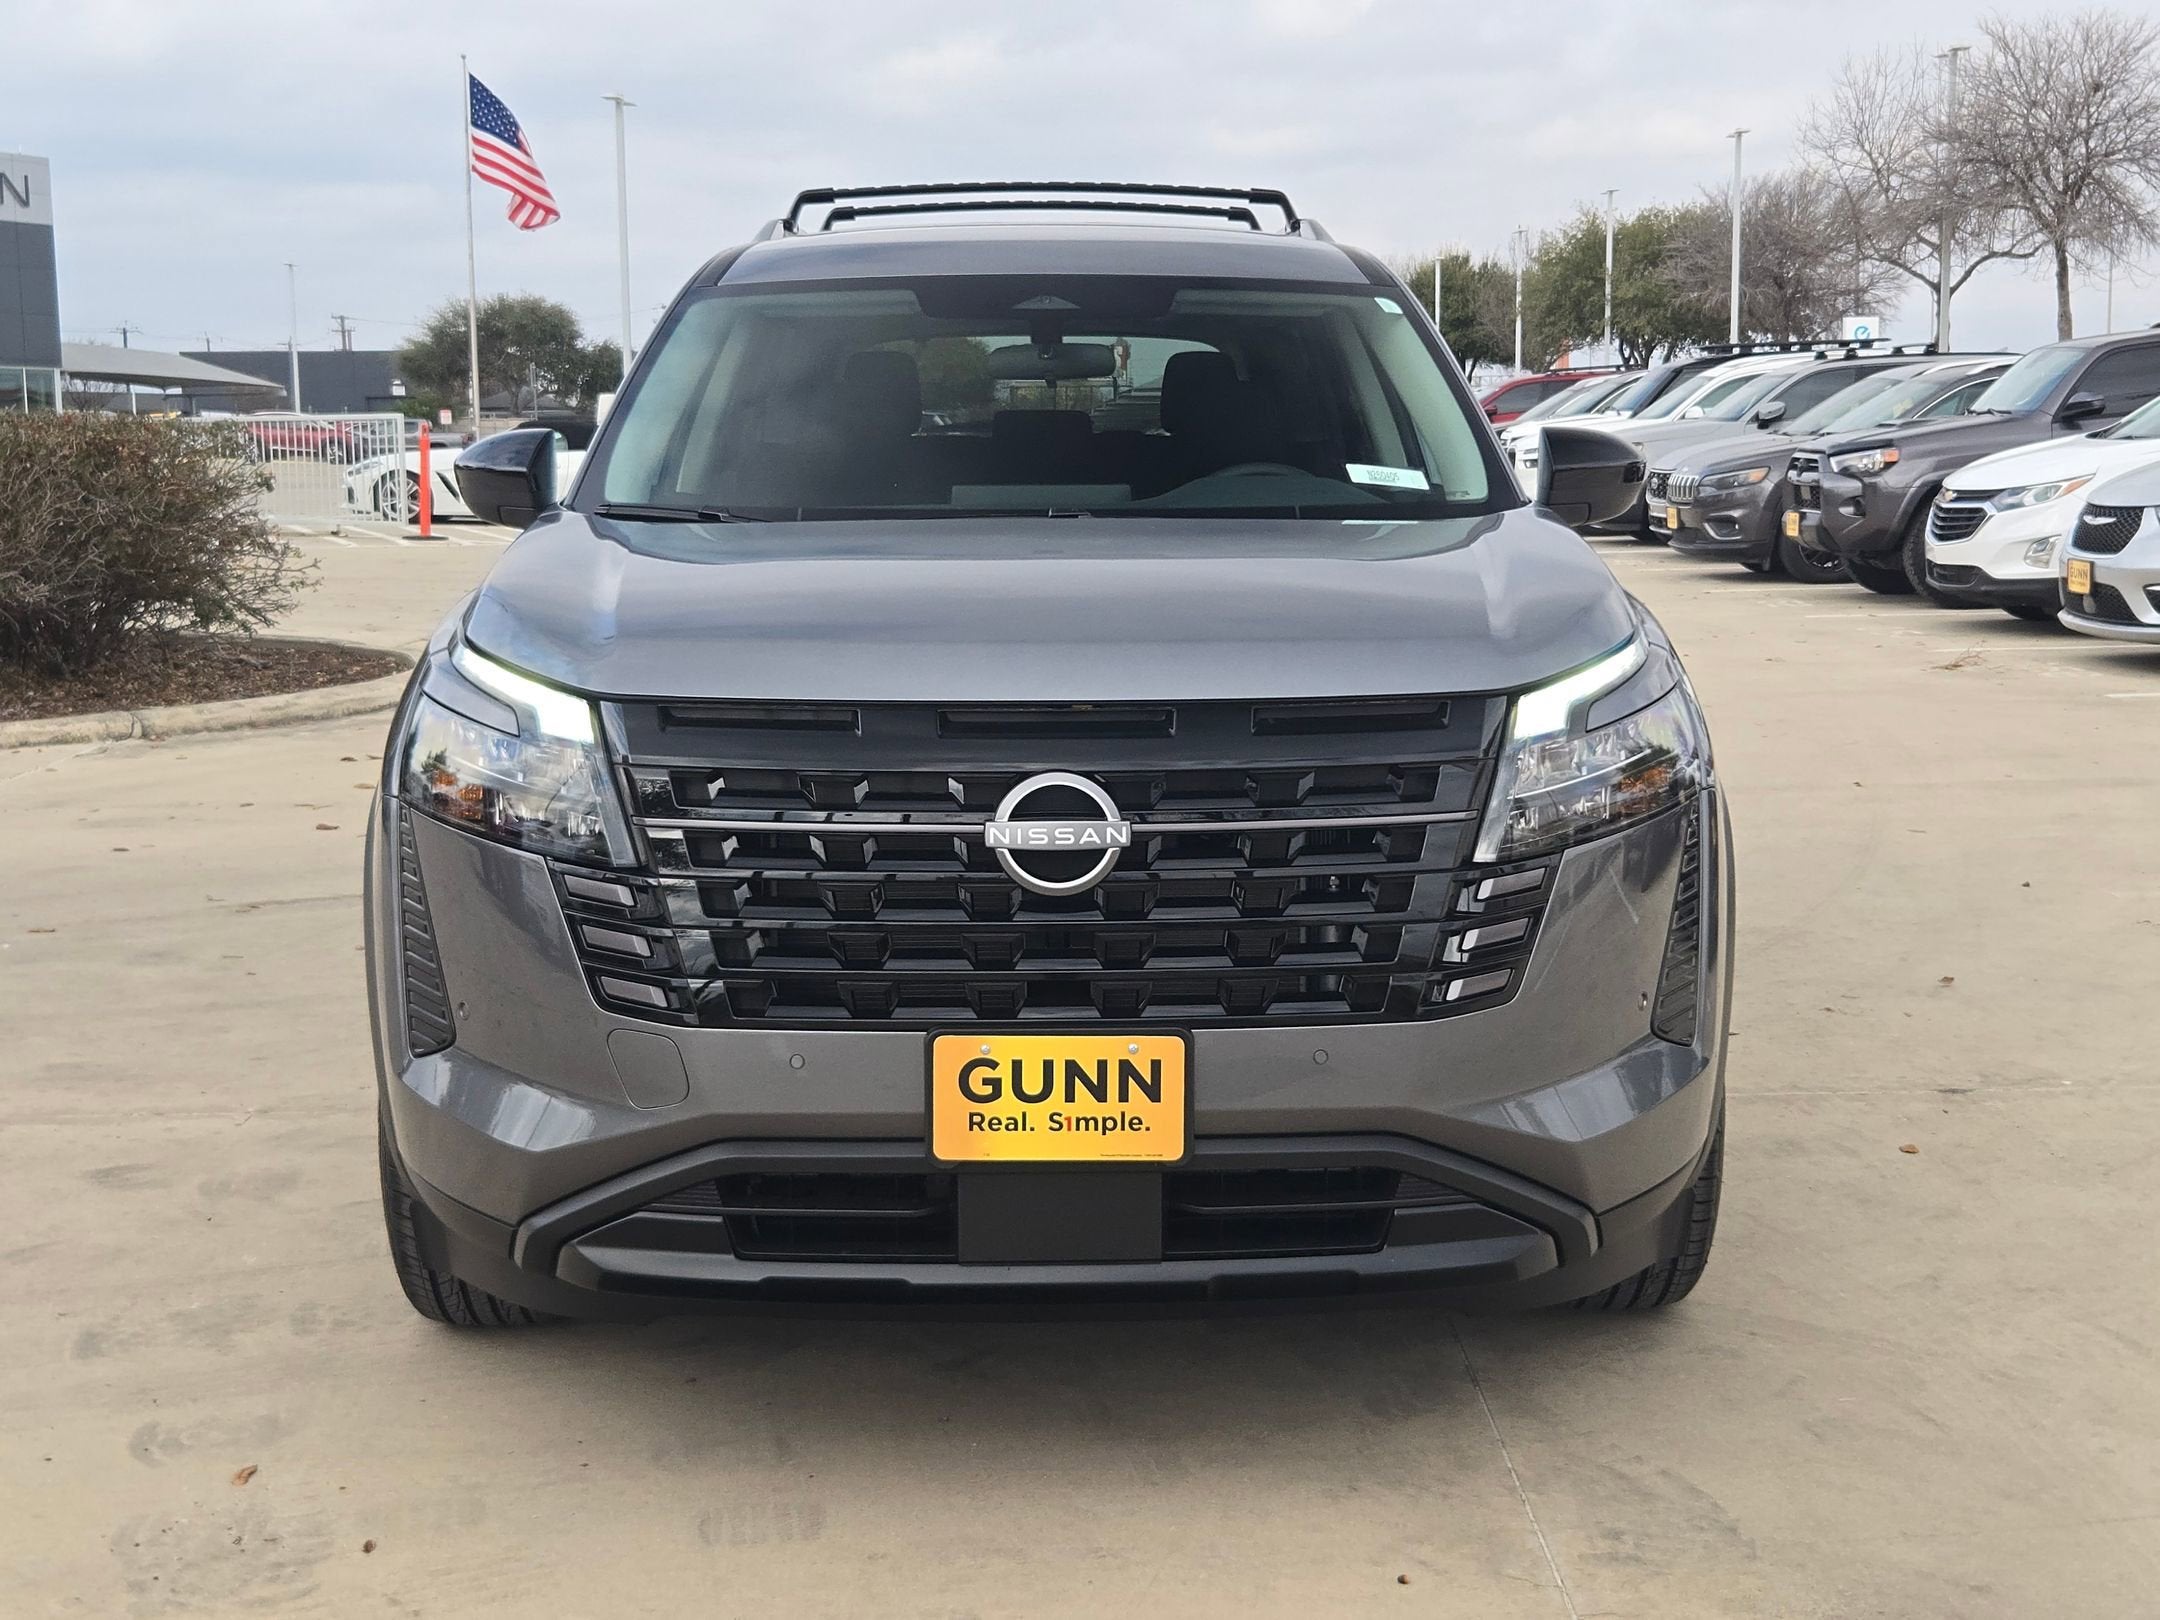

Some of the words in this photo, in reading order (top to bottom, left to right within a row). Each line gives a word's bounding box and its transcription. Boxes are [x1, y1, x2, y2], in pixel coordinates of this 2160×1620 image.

[989, 826, 1127, 845] NISSAN
[958, 1057, 1162, 1104] GUNN
[968, 1111, 1035, 1132] Real.
